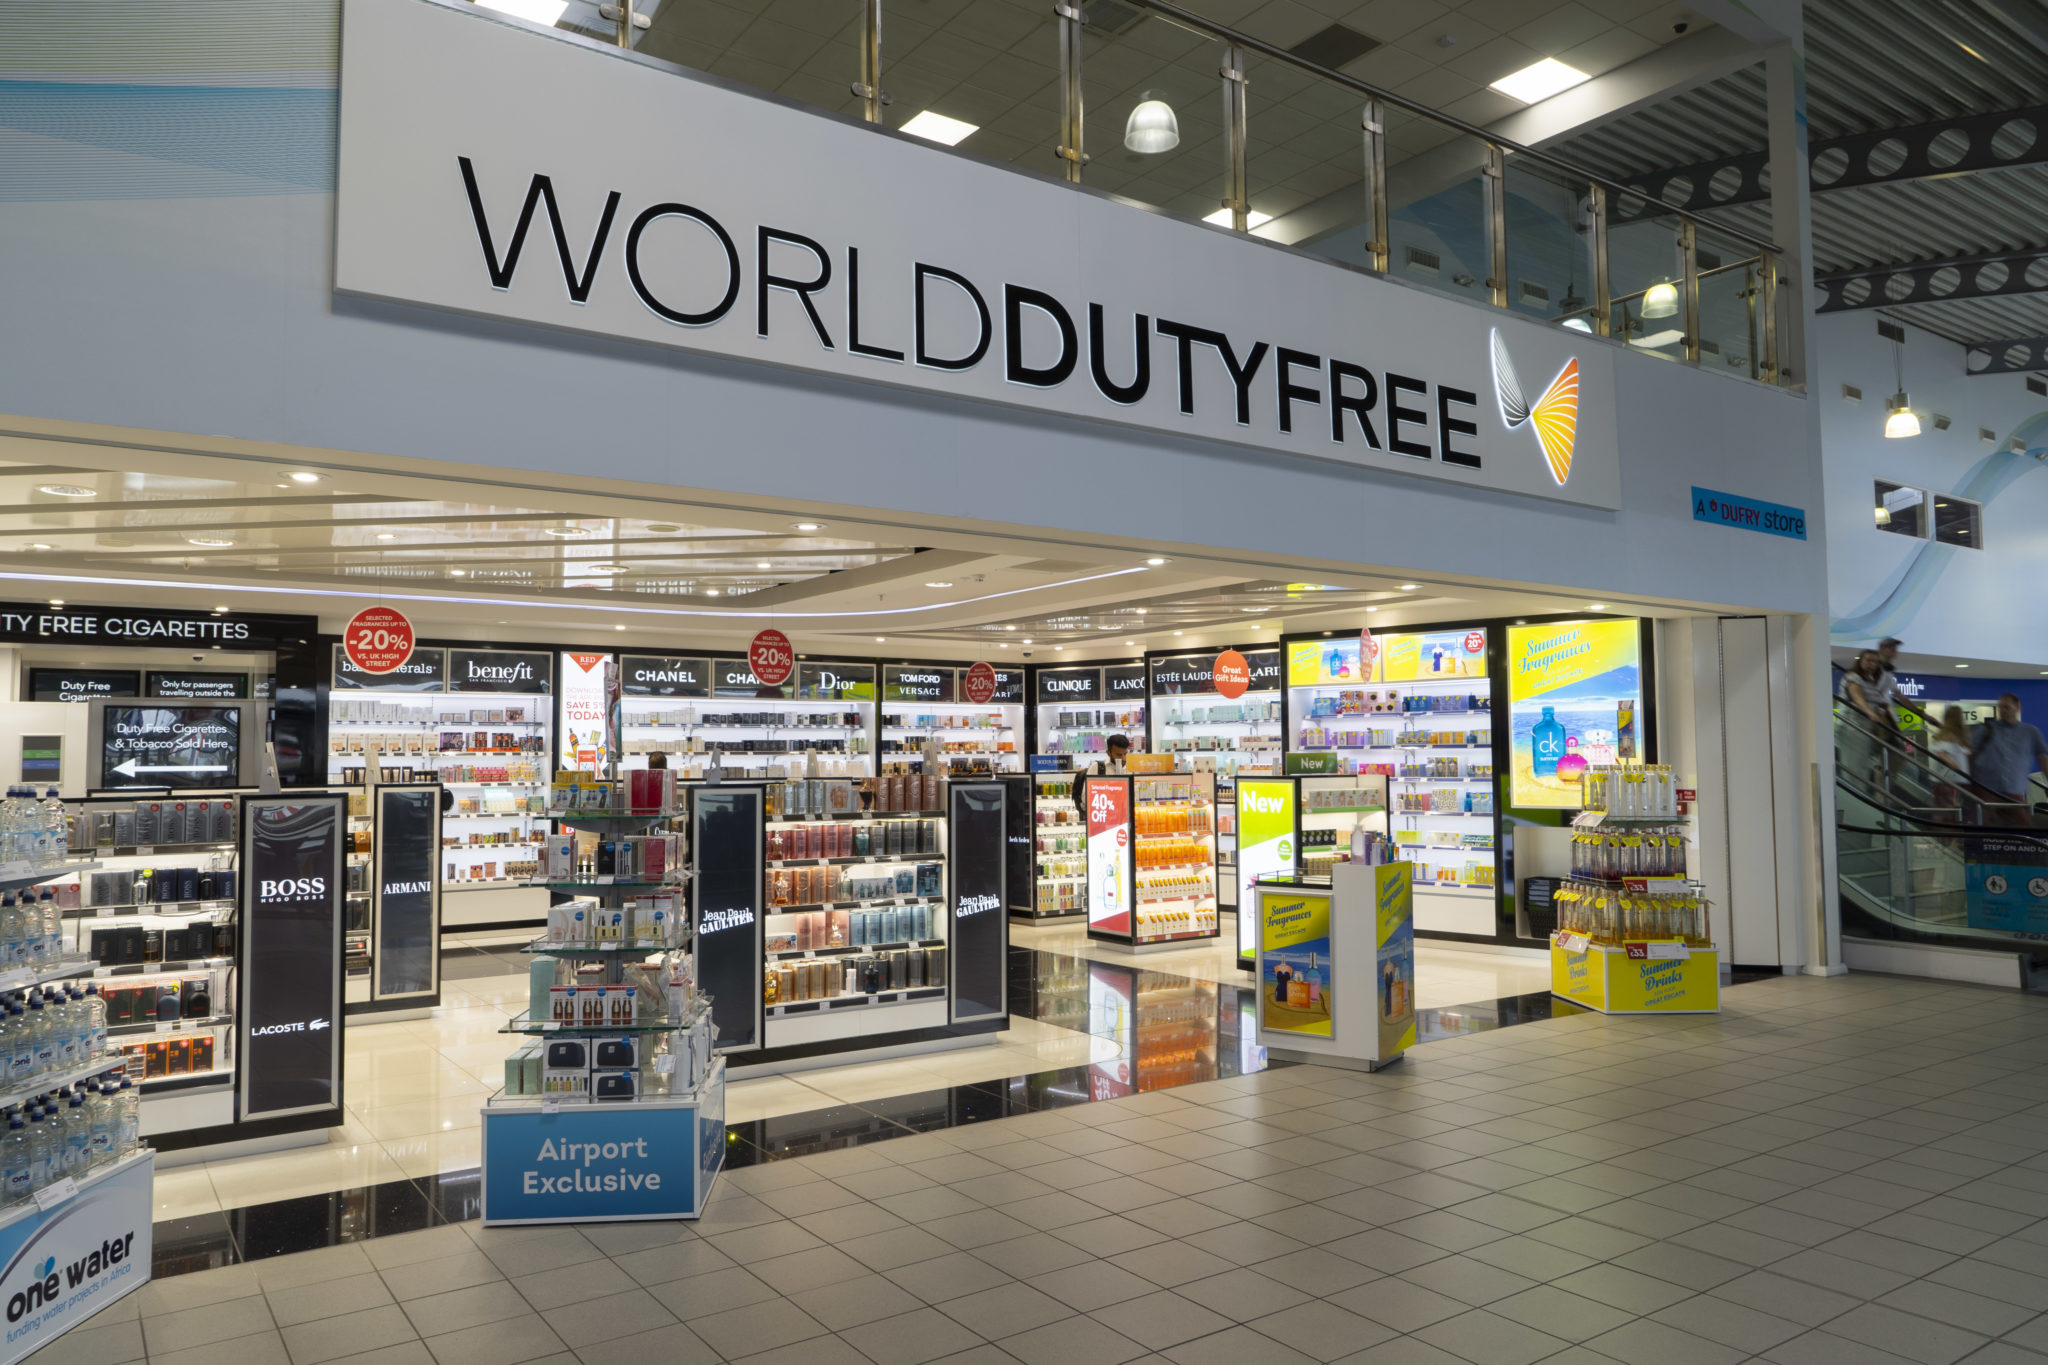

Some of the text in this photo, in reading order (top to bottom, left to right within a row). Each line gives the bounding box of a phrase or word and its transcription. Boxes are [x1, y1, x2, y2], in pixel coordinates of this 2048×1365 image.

[1721, 503, 1760, 527] DUFRY
[1764, 510, 1804, 534] store
[0, 613, 249, 639] TY FREE CIGARETTES
[349, 630, 408, 650] -20%
[1527, 629, 1581, 657] Summer
[752, 648, 791, 666] -20%
[1518, 641, 1591, 674] Fragrances
[467, 660, 533, 683] benefit
[635, 670, 696, 683] CHANEL
[1182, 671, 1214, 681] LAUDE
[1222, 665, 1241, 674] Great
[1247, 666, 1280, 677] LARI
[162, 681, 180, 690] Only
[192, 682, 233, 690] passengers
[819, 672, 856, 690] Dior
[900, 674, 941, 683] TOM FORD
[968, 677, 993, 690] -20%
[1047, 679, 1092, 692] CLINIQUE
[1215, 674, 1248, 683] Gift Ideas
[61, 681, 111, 692] Duty Free
[899, 687, 940, 695] VERSACE
[160, 690, 193, 698] travelling
[566, 701, 590, 709] SAVE
[567, 711, 606, 720] TODAY
[117, 723, 227, 736] Duty Free Cigarettes
[115, 739, 228, 748] & Tobacco Sold Here
[1539, 731, 1559, 753] ck
[1301, 757, 1323, 769] New
[1091, 793, 1115, 810] 40%
[1242, 790, 1284, 813] New
[1091, 810, 1107, 823] Off
[260, 878, 325, 898] BOSS
[383, 881, 431, 895] ARMANI
[956, 898, 1000, 918] GAULTIER
[959, 896, 978, 906] Jean
[703, 907, 750, 921] Jean Paul
[1271, 901, 1305, 916] Summer
[699, 912, 754, 935] GAULTIER
[1266, 910, 1311, 928] Fragrances
[1640, 959, 1684, 978] Summer
[1645, 970, 1682, 991] Drinks
[251, 1022, 305, 1036] LACOSTE
[537, 1137, 648, 1167] Airport
[523, 1168, 661, 1194] Exclusive
[6, 1231, 134, 1323] one water
[6, 1263, 131, 1344] funding water projects in Africa
